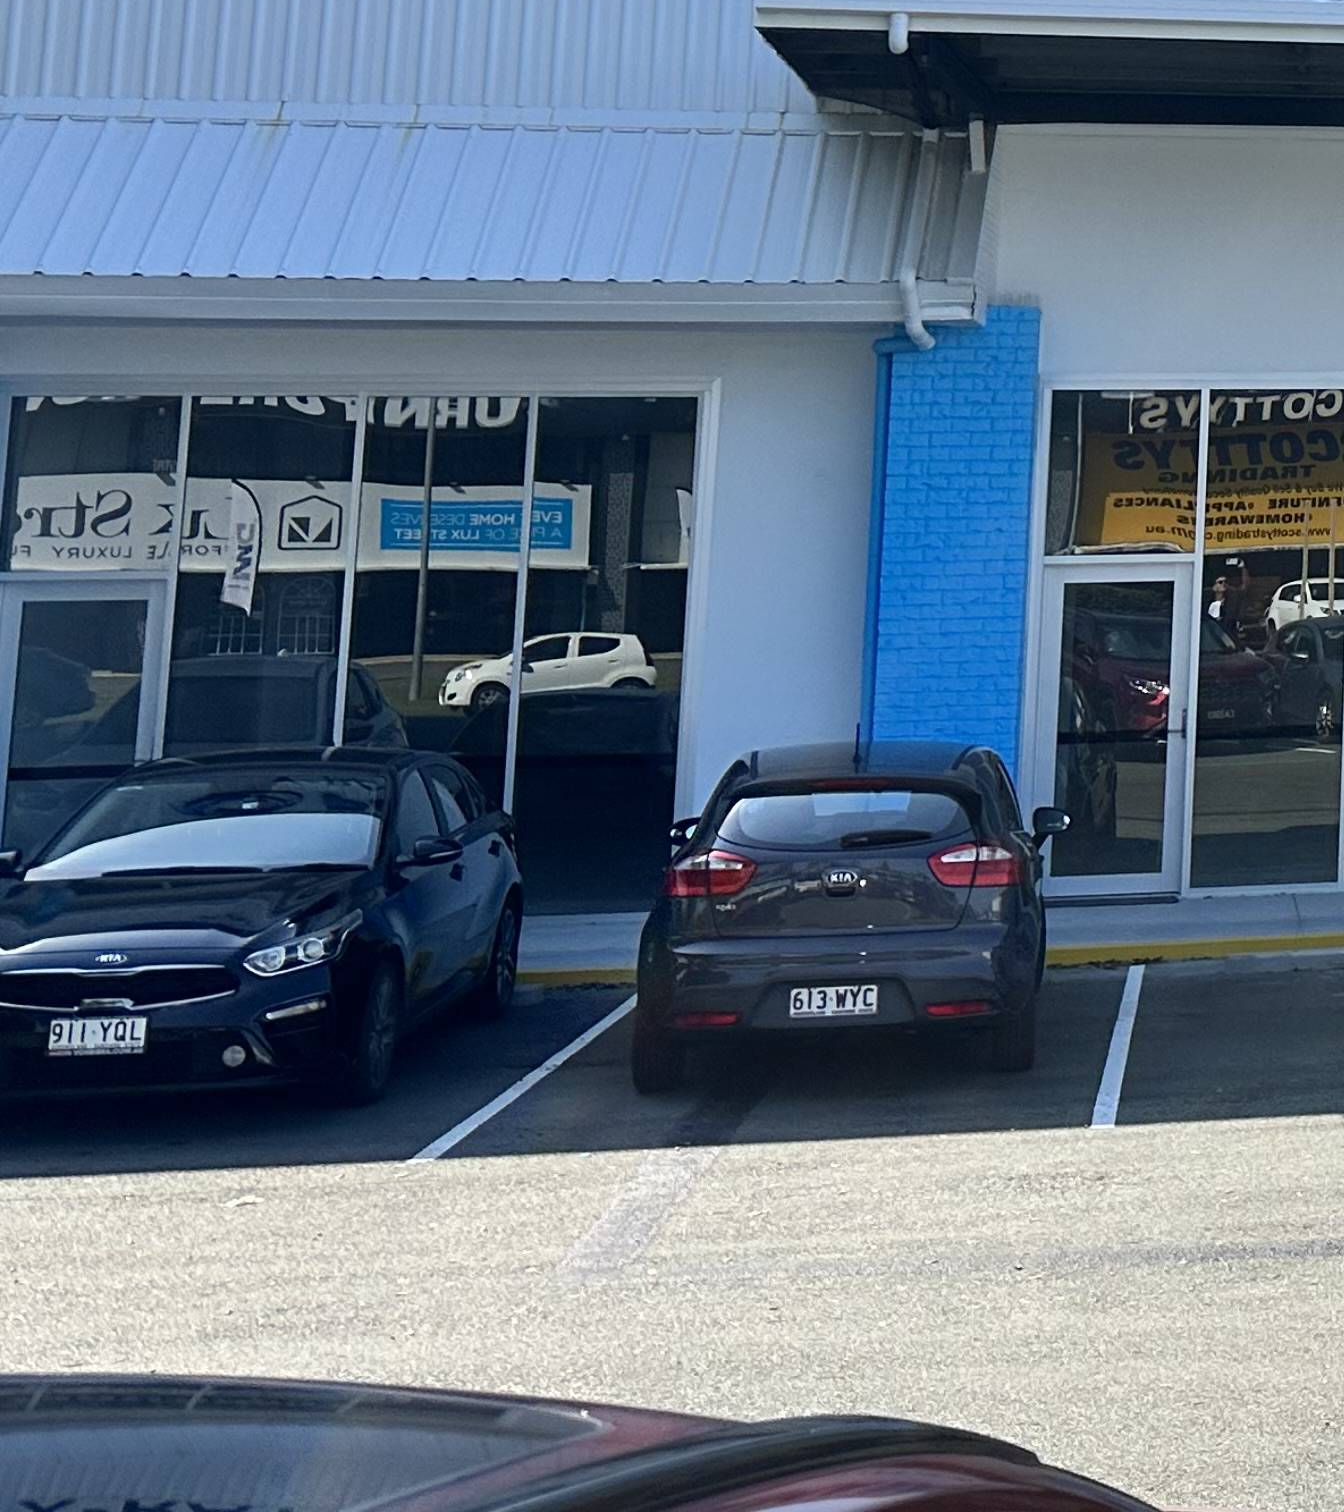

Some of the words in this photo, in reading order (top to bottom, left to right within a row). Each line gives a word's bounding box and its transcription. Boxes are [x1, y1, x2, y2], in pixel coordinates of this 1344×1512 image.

[830, 873, 852, 883] KIA
[793, 989, 827, 1010] 613
[835, 988, 873, 1009] WYC
[52, 1022, 86, 1043] 911
[100, 1021, 142, 1042] YQL
